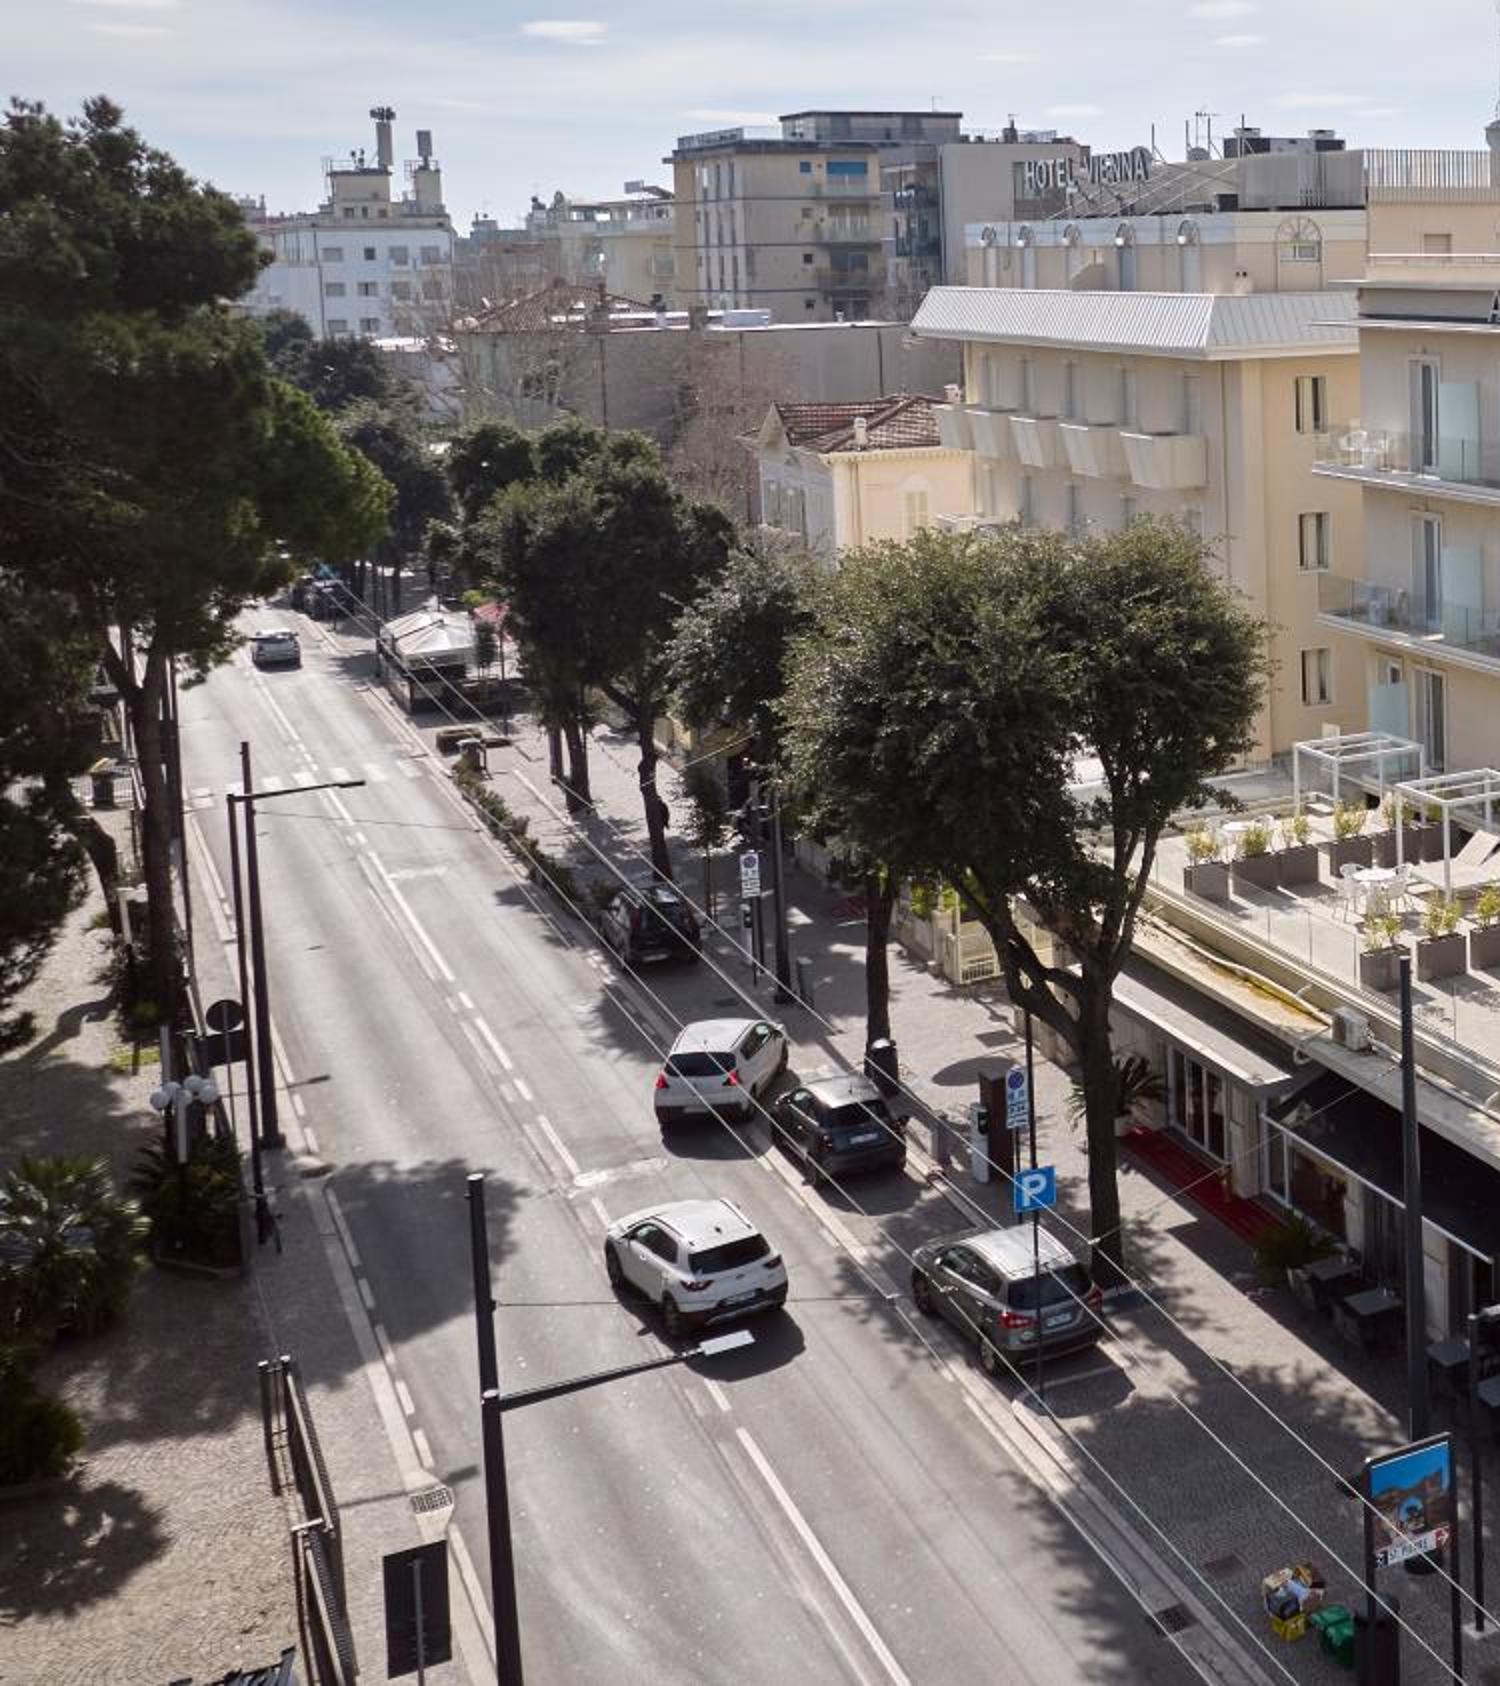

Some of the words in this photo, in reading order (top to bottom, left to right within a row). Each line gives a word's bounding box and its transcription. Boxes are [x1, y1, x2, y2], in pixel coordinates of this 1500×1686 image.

[1025, 158, 1078, 190] HOTEL
[1081, 151, 1150, 184] VIENNA
[1022, 1173, 1047, 1207] P
